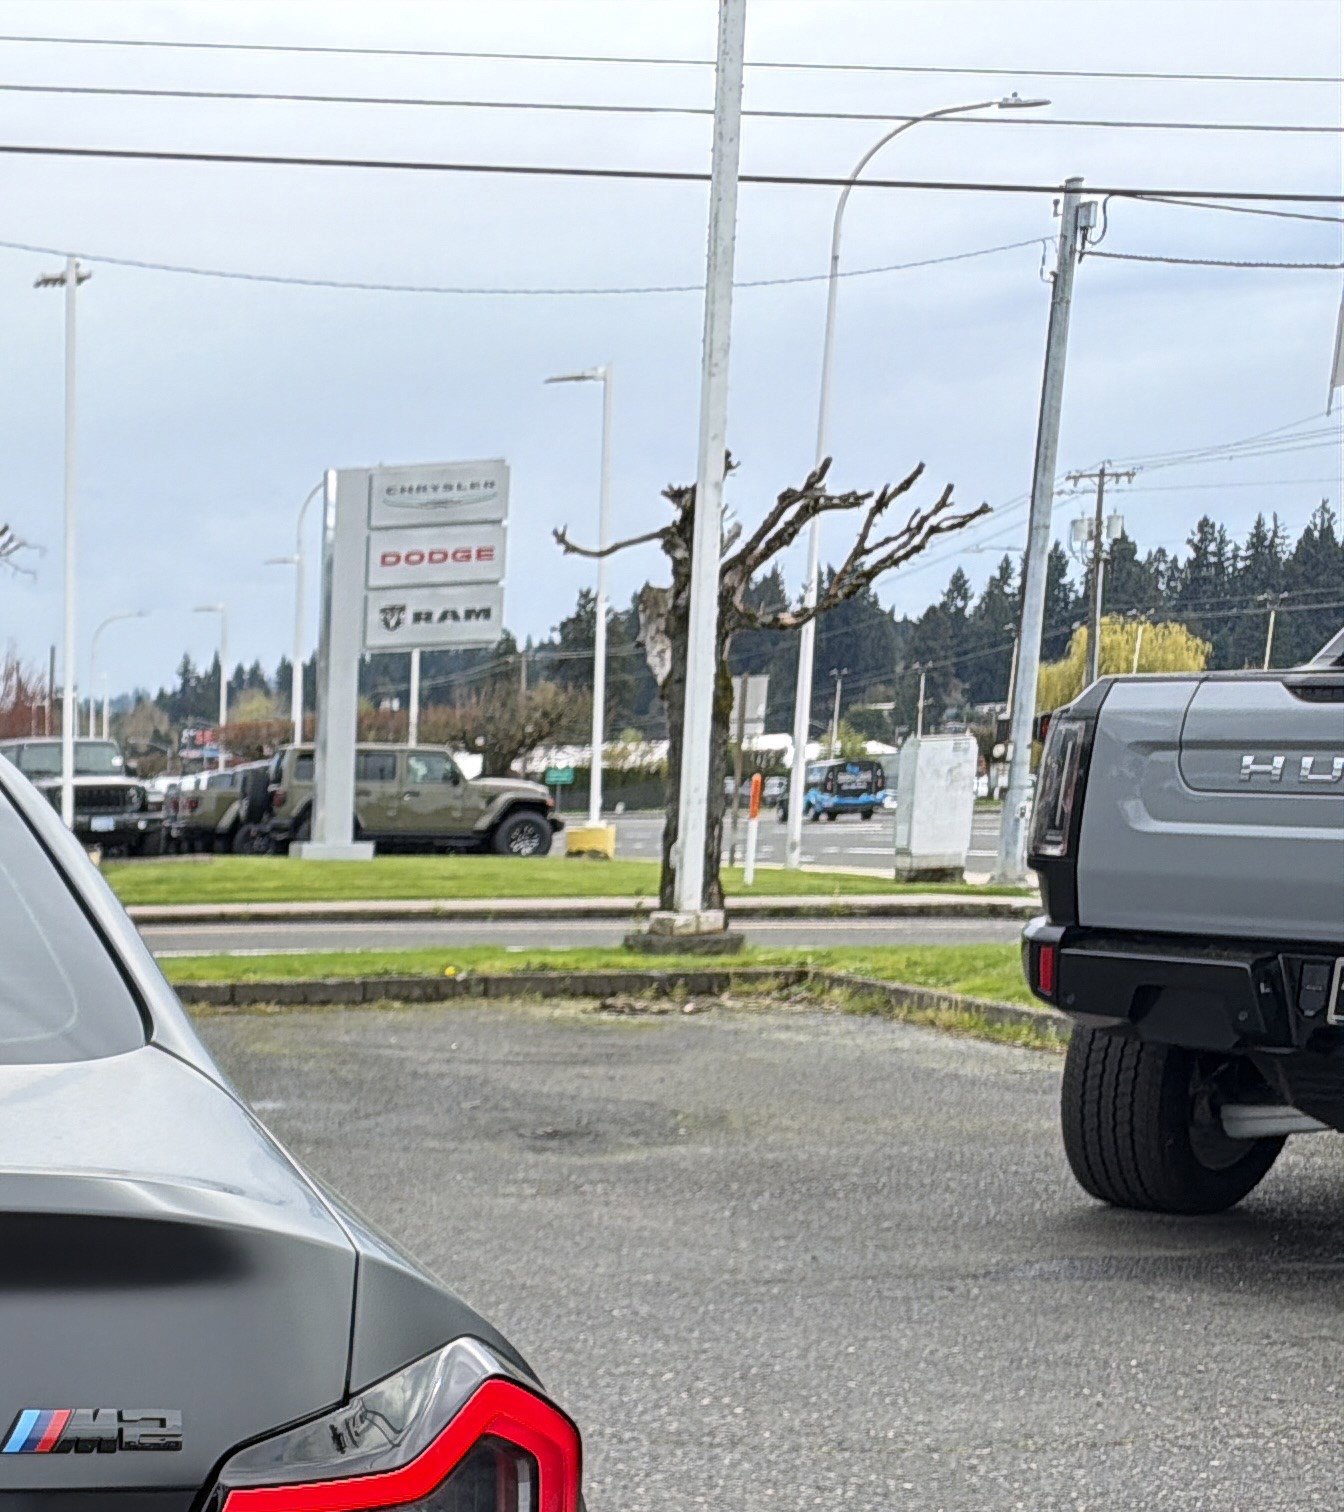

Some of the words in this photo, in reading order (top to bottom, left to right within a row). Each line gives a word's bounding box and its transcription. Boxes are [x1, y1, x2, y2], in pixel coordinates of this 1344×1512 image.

[385, 480, 496, 496] CHRYSLER
[378, 545, 495, 568] DODGE
[412, 607, 492, 624] RAM
[52, 1408, 183, 1455] M2
